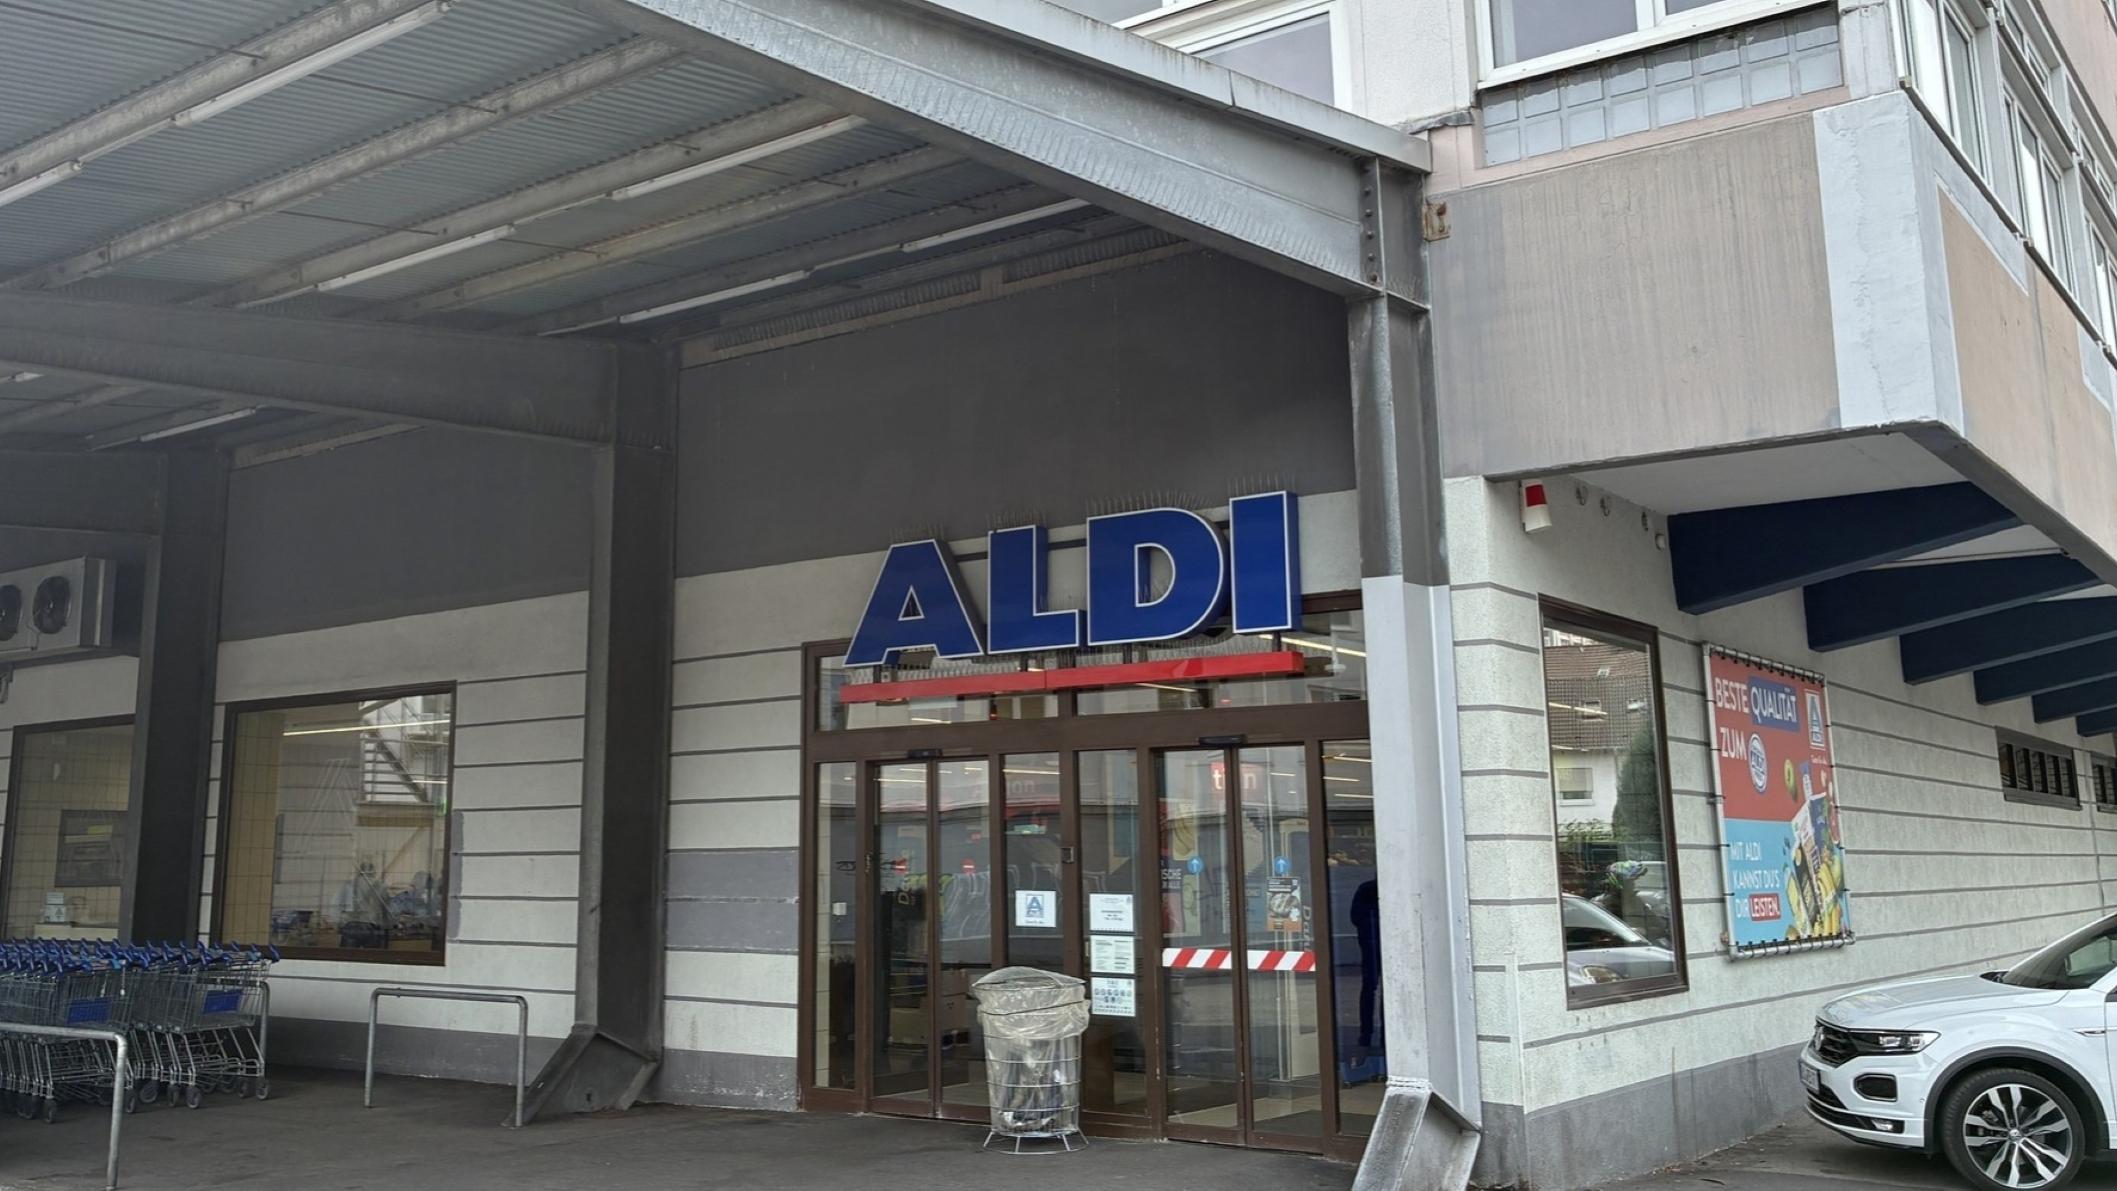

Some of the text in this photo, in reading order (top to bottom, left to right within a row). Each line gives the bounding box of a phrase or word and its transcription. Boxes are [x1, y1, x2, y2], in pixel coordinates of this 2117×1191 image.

[843, 490, 1300, 668] ALDI
[1715, 677, 1798, 724] BESTE QUALITÄT
[1719, 726, 1748, 761] ZUM
[1730, 841, 1761, 861] MIT ALDI
[1733, 869, 1763, 889] KANNST
